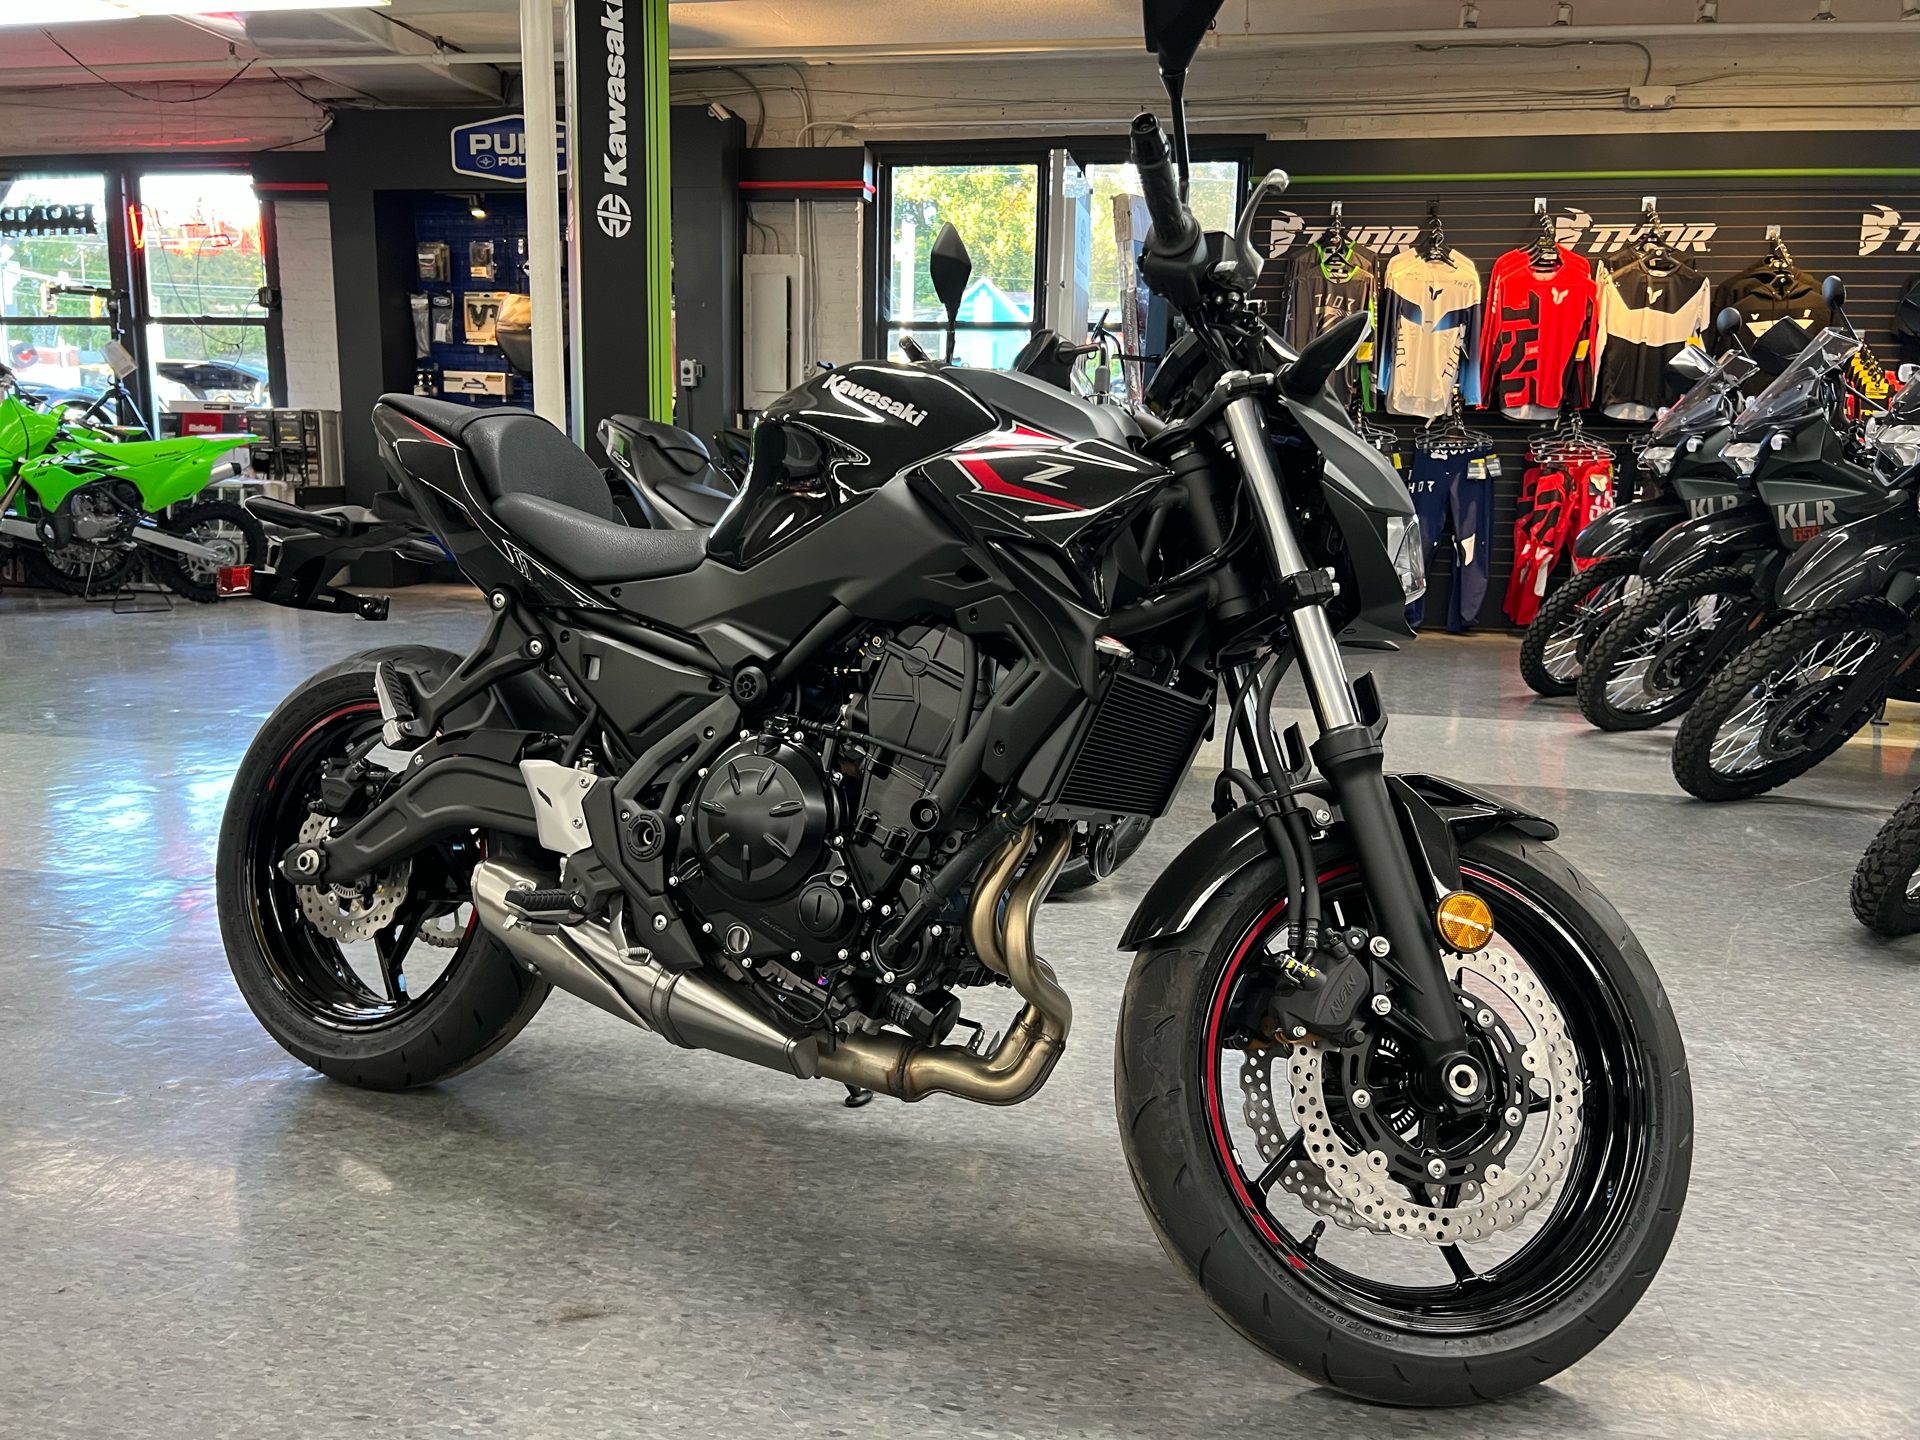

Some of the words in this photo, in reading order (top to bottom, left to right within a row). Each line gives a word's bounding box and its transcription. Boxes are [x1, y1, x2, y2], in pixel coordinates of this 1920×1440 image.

[822, 373, 928, 427] Kawasaki
[611, 450, 631, 468] 500
[1777, 499, 1839, 529] KLR
